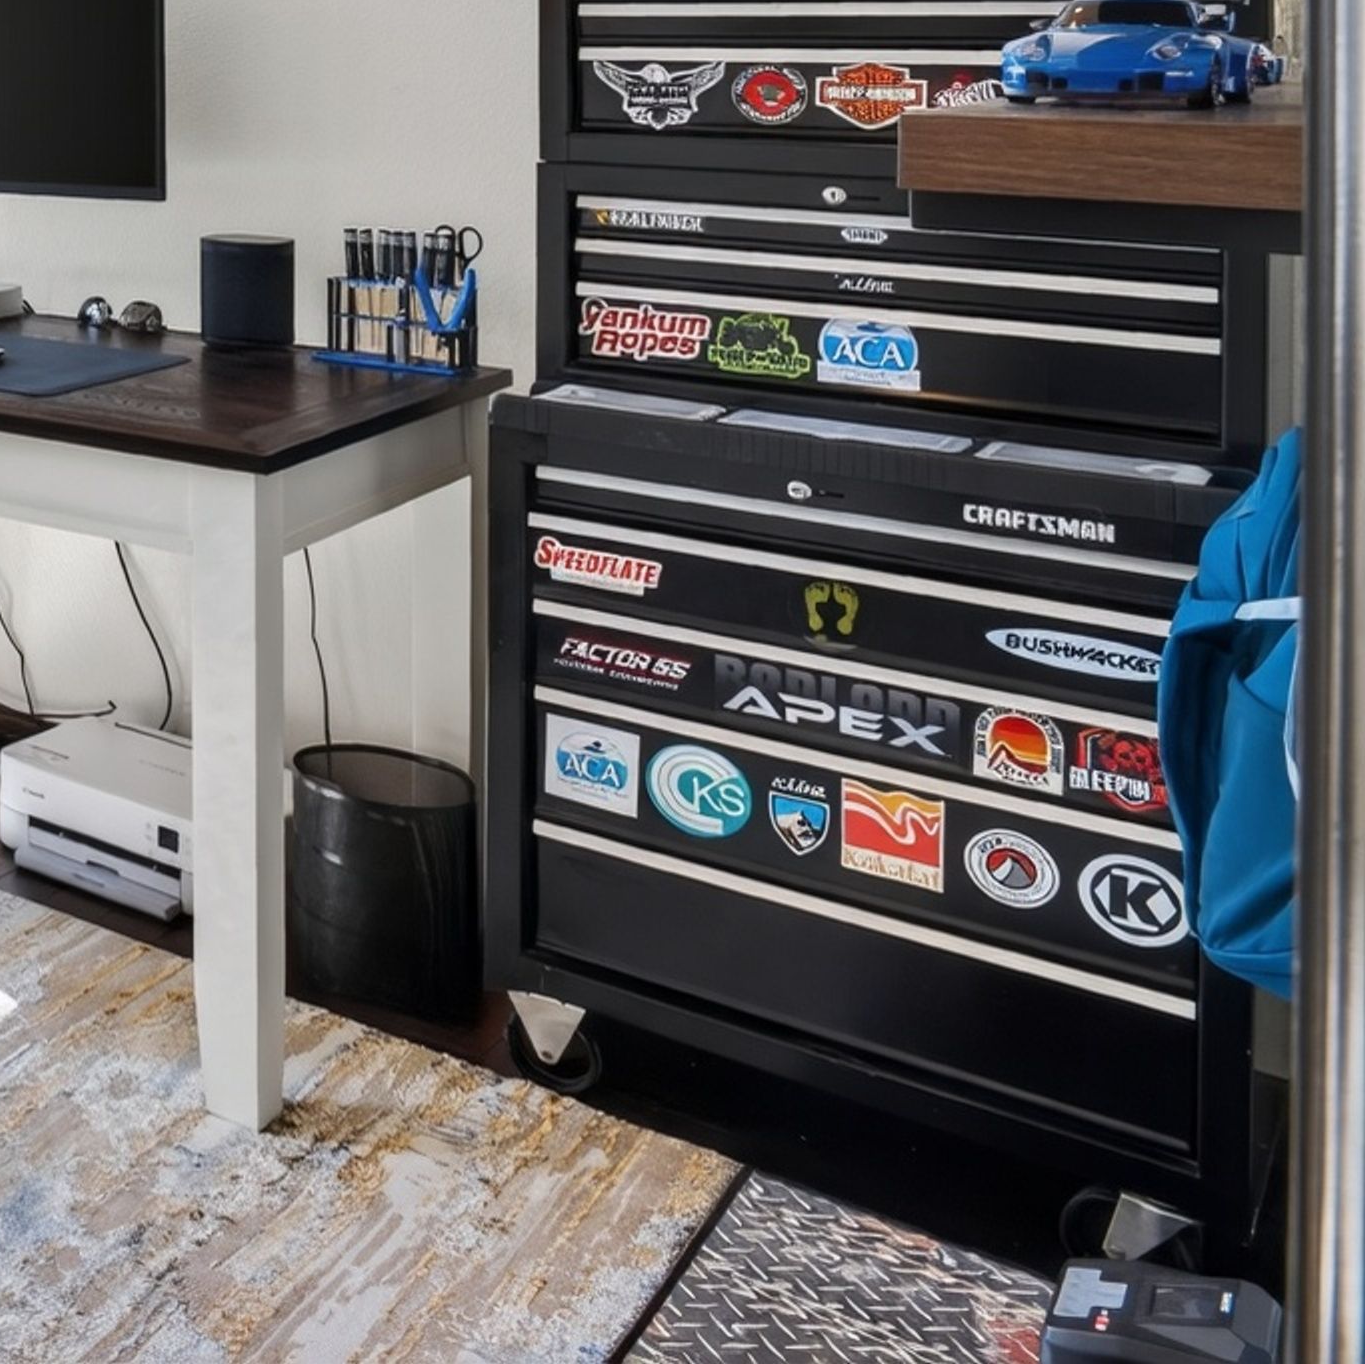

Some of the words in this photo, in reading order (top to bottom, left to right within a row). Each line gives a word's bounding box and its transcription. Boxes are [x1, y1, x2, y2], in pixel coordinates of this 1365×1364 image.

[833, 337, 906, 370] ACA
[962, 503, 1117, 544] CRAFTSMAN
[560, 637, 652, 671] FACTOR
[722, 685, 947, 757] APEX
[564, 752, 620, 787] ACA
